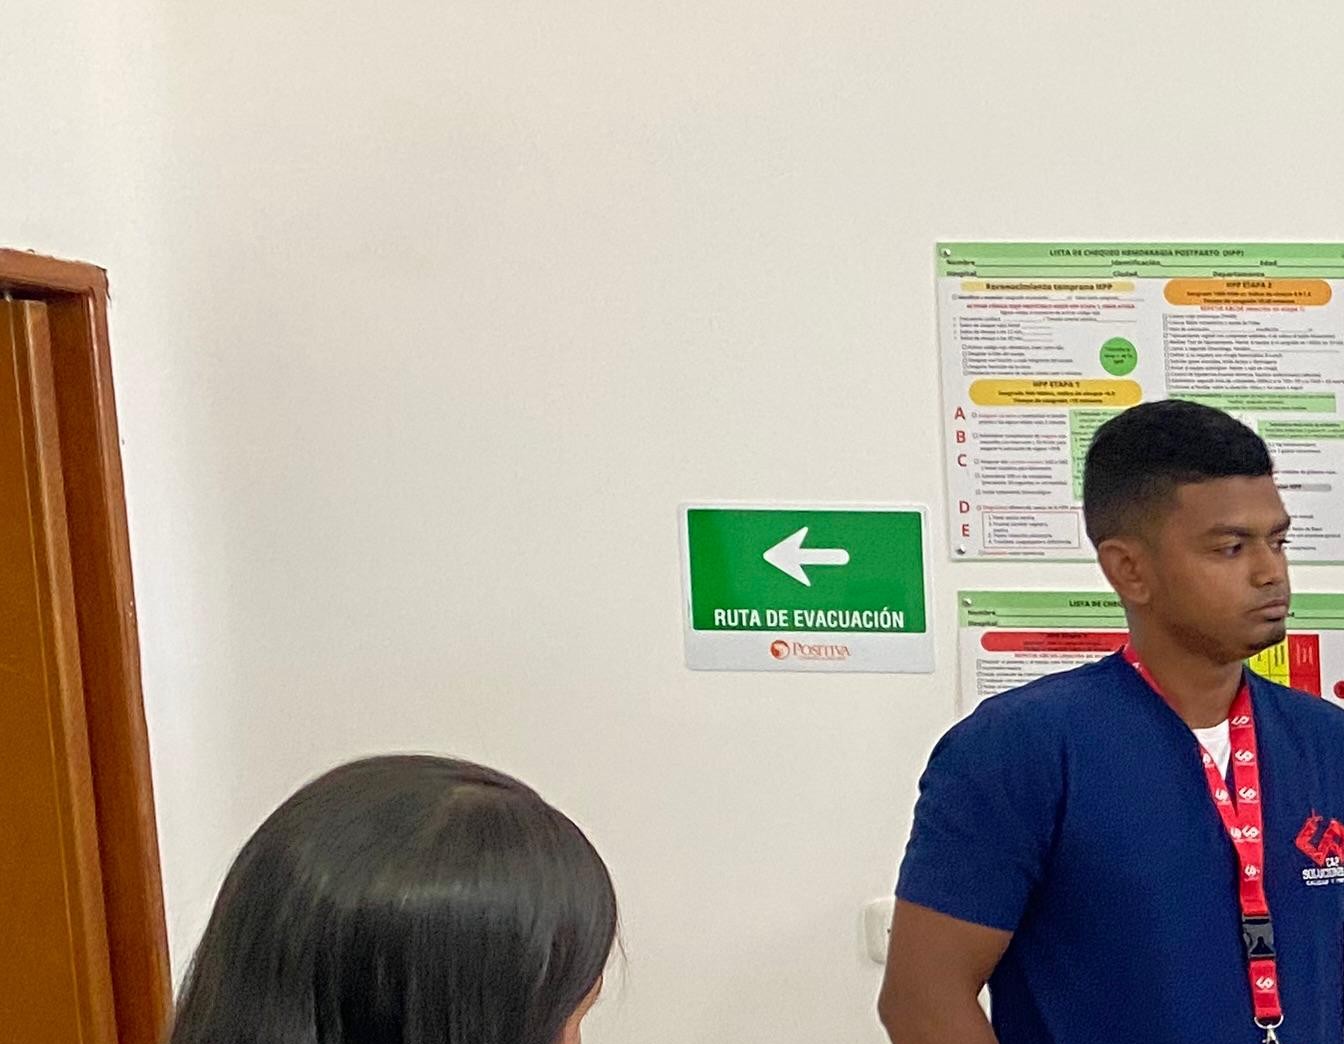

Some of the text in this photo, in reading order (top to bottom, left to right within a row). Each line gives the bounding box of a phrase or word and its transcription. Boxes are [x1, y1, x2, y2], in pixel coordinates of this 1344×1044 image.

[954, 407, 965, 420] A
[956, 431, 966, 443] B
[957, 454, 967, 467] C
[959, 501, 969, 513] D
[962, 524, 969, 537] E
[714, 607, 904, 628] RUTA DE EVACUACIÓN
